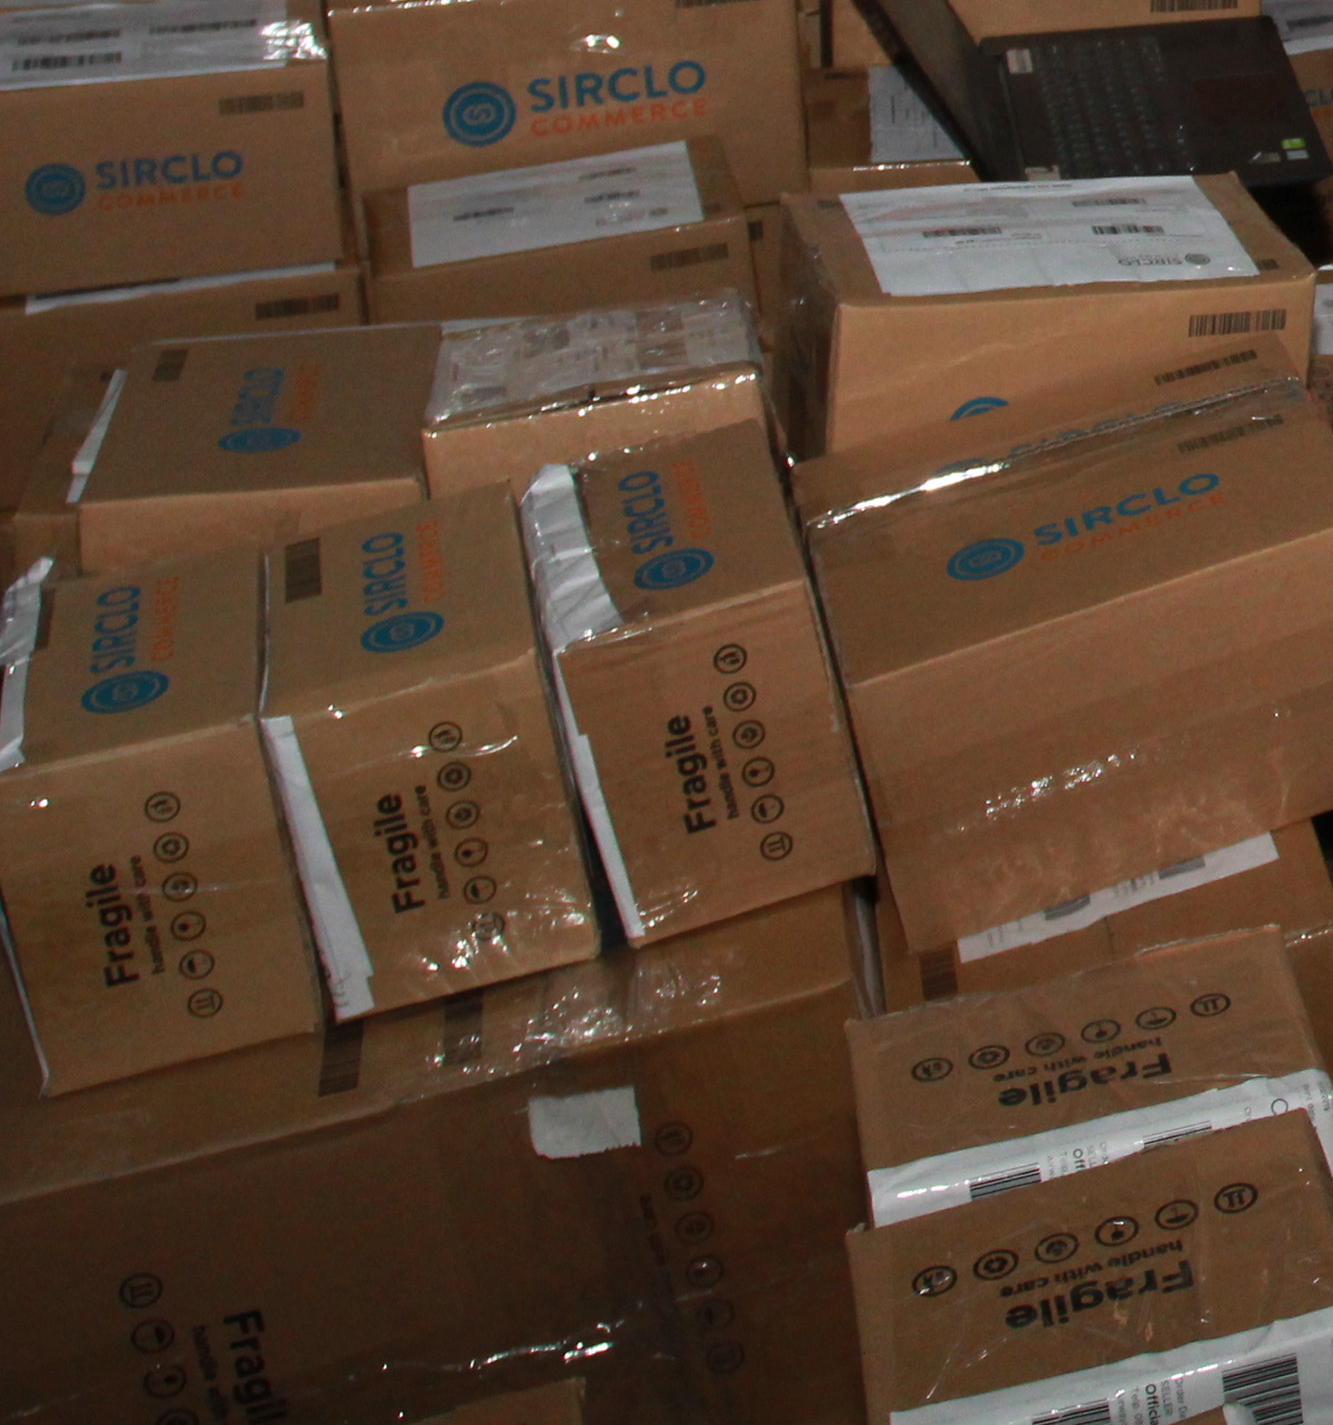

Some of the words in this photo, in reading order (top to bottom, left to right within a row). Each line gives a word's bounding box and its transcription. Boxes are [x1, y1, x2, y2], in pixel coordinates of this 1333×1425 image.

[528, 60, 706, 113] SIRCLO
[530, 97, 708, 138] COMMERCE
[96, 151, 243, 190] SIRCLO
[98, 182, 245, 212] COMMERCE
[1118, 255, 1183, 266] SIRCLO
[618, 471, 675, 554] SIRCLO
[1034, 473, 1220, 545] SIRCLO
[1037, 493, 1225, 564] COMMERCE
[362, 533, 406, 615] SIRCLO
[90, 587, 141, 673] SIRCLO
[667, 709, 713, 836] Fragile
[414, 785, 431, 817] care
[374, 793, 427, 914] Fragile
[424, 820, 438, 853] with
[131, 855, 144, 888] care
[433, 857, 451, 899] handle
[85, 864, 139, 988] Fragile
[139, 892, 154, 925] with
[150, 931, 165, 975] handle
[1057, 1053, 1111, 1073] with
[1115, 1038, 1163, 1060] handle
[996, 1051, 1172, 1107] Fragile
[1050, 1256, 1106, 1288] with
[1108, 1240, 1182, 1268] handle
[999, 1277, 1050, 1298] care
[1003, 1258, 1194, 1329] Fragile
[1162, 1380, 1178, 1416] SELLER
